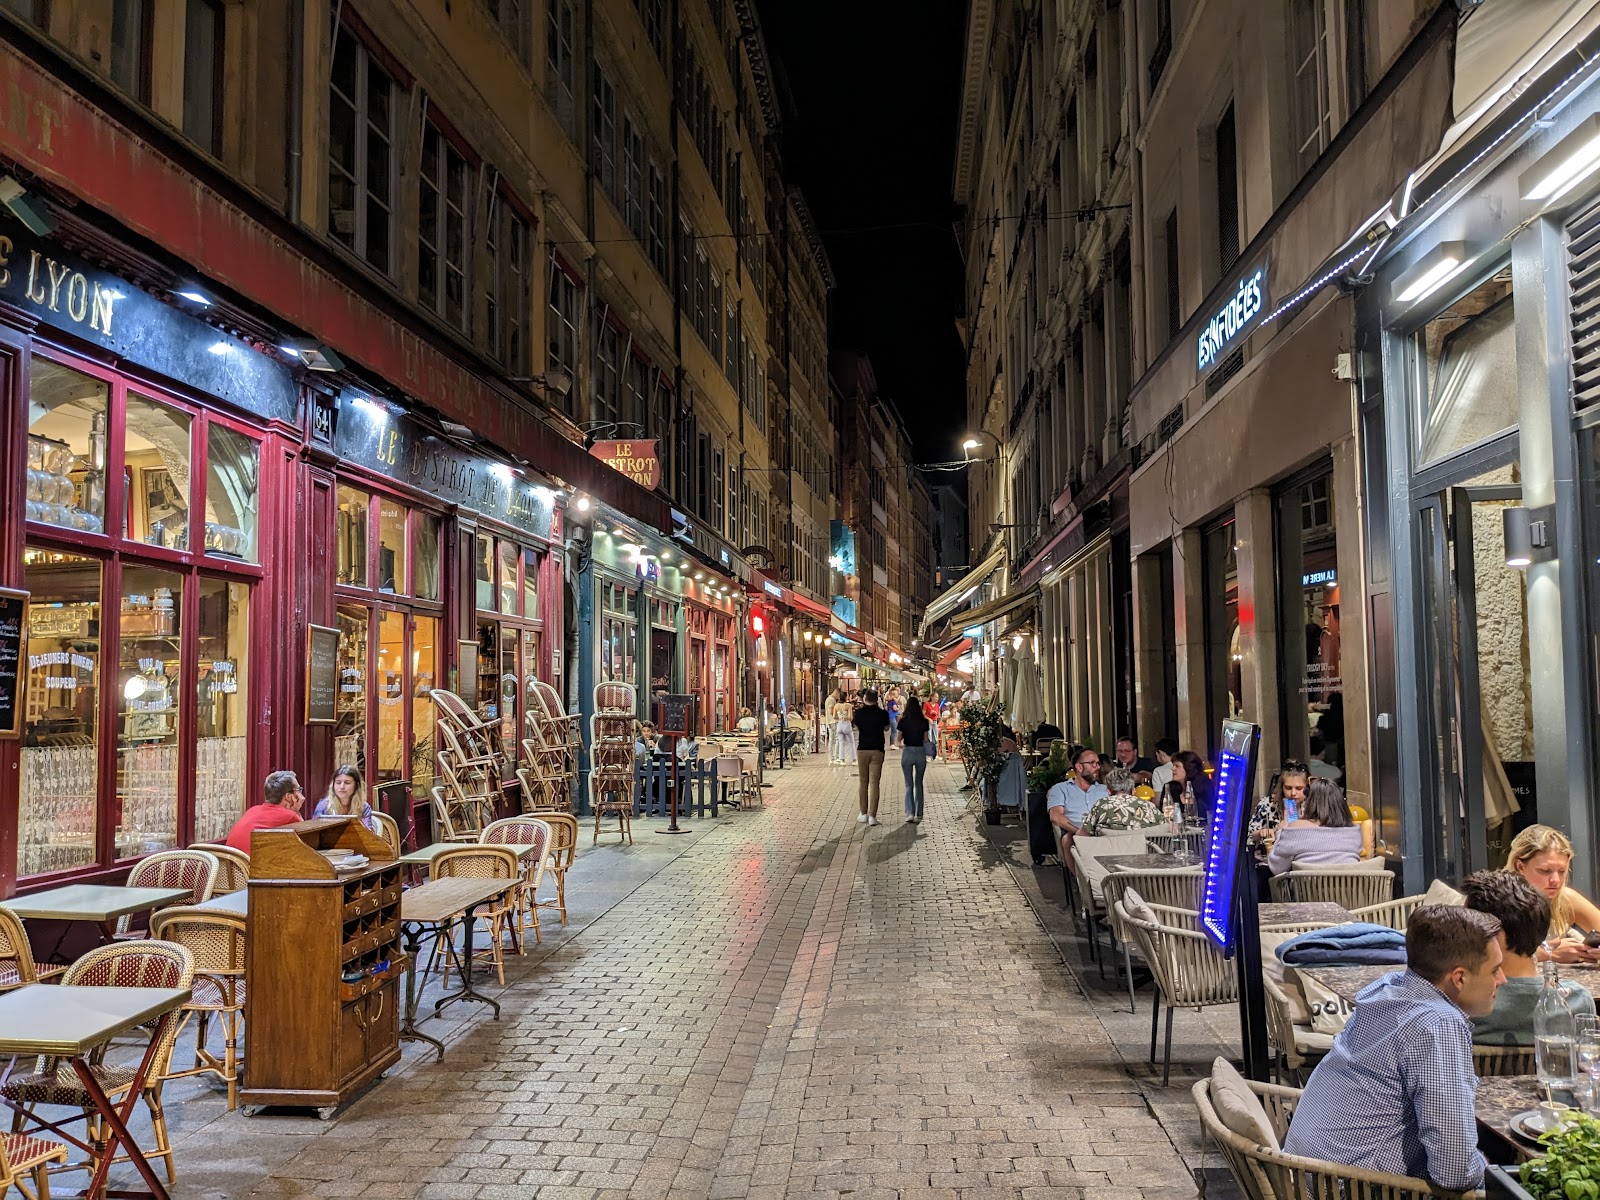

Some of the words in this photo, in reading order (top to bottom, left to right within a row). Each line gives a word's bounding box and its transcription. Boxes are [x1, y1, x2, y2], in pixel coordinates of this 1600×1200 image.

[25, 250, 112, 336] LYON
[315, 405, 329, 433] 64
[377, 425, 398, 466] LE
[411, 441, 476, 498] BISTROT
[615, 443, 633, 457] LE
[29, 651, 69, 670] DEJEUNERS
[45, 676, 77, 689] SOUPERS
